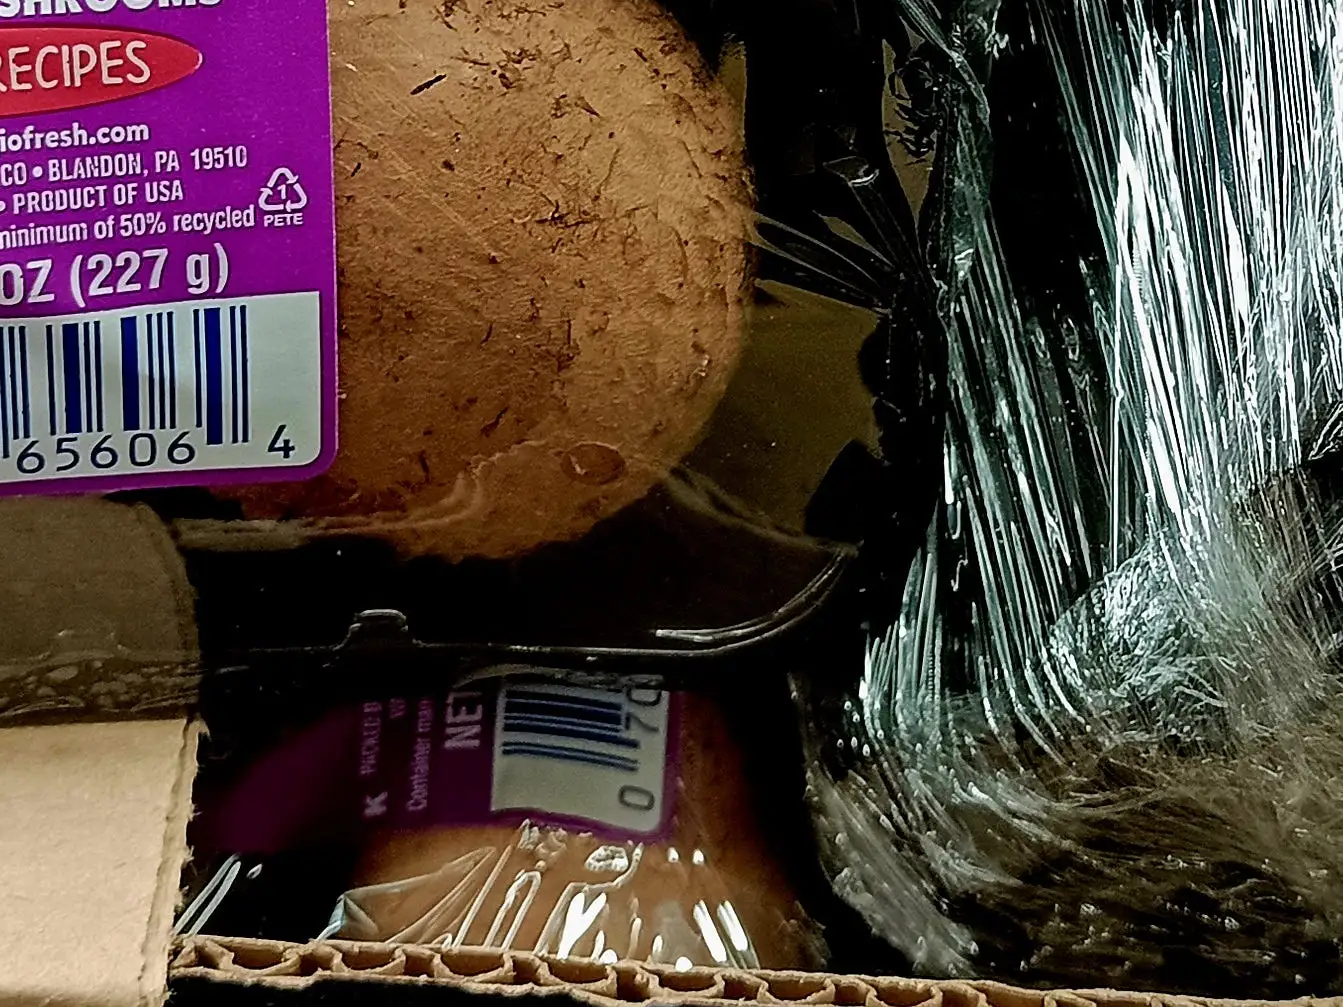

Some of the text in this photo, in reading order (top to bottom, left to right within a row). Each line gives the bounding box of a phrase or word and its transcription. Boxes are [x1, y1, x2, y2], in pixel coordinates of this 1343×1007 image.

[0, 163, 27, 186] CO
[48, 153, 149, 182] BLANDON,
[155, 149, 180, 173] PA
[191, 145, 248, 169] 19510
[13, 184, 107, 215] PRODUCT
[113, 182, 138, 205] OF
[145, 179, 184, 203] USA
[93, 215, 115, 239] of
[119, 212, 167, 237] 50%
[173, 204, 256, 234] recycled
[264, 213, 304, 227] PETE
[70, 247, 168, 308] (227
[186, 242, 229, 294] g)
[16, 431, 197, 475] 65606
[268, 423, 297, 460] 4
